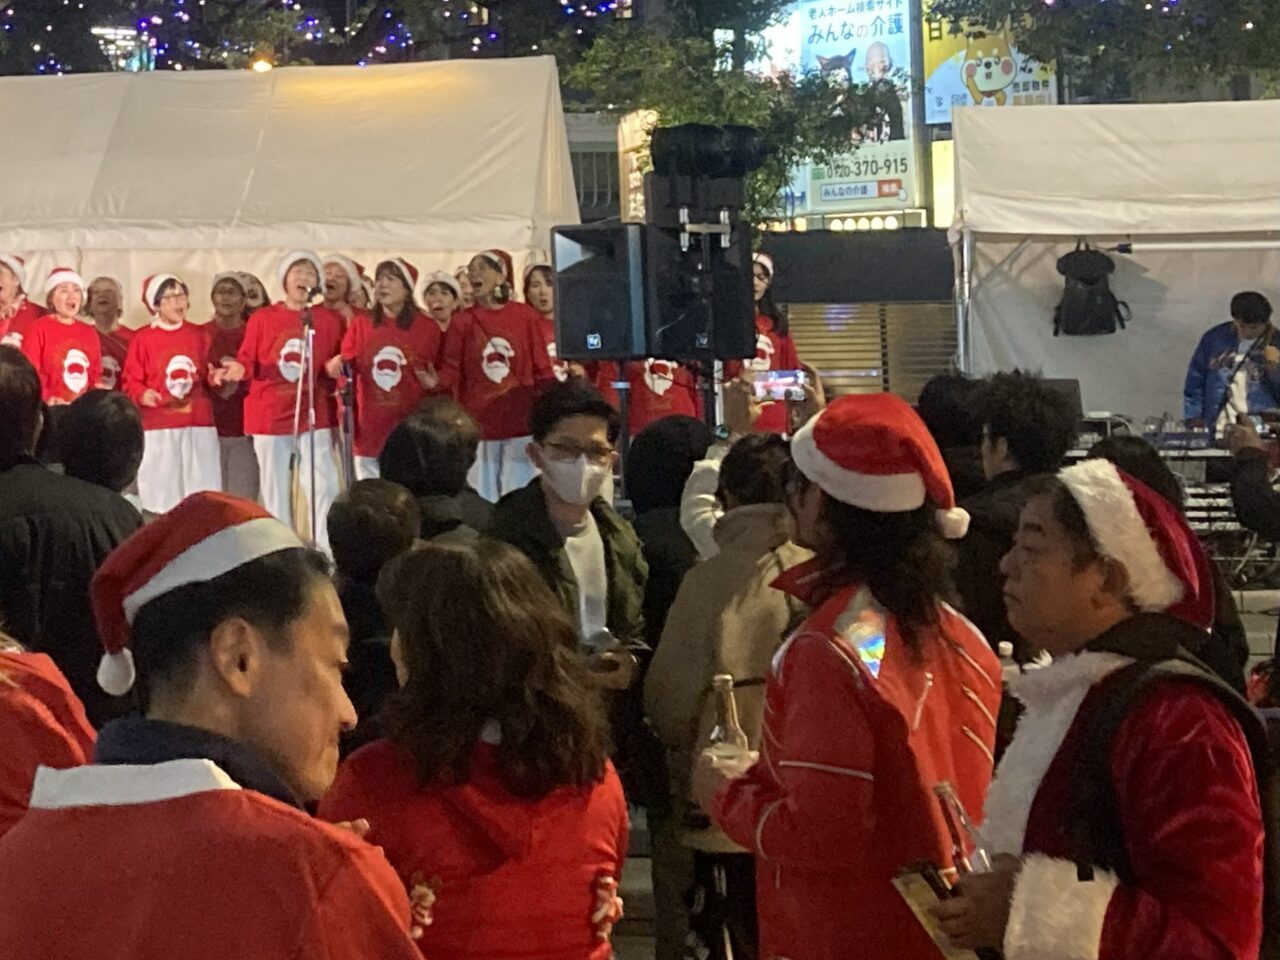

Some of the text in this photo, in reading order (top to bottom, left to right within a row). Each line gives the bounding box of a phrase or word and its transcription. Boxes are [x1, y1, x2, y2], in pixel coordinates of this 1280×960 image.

[808, 13, 905, 44] みんなの介護
